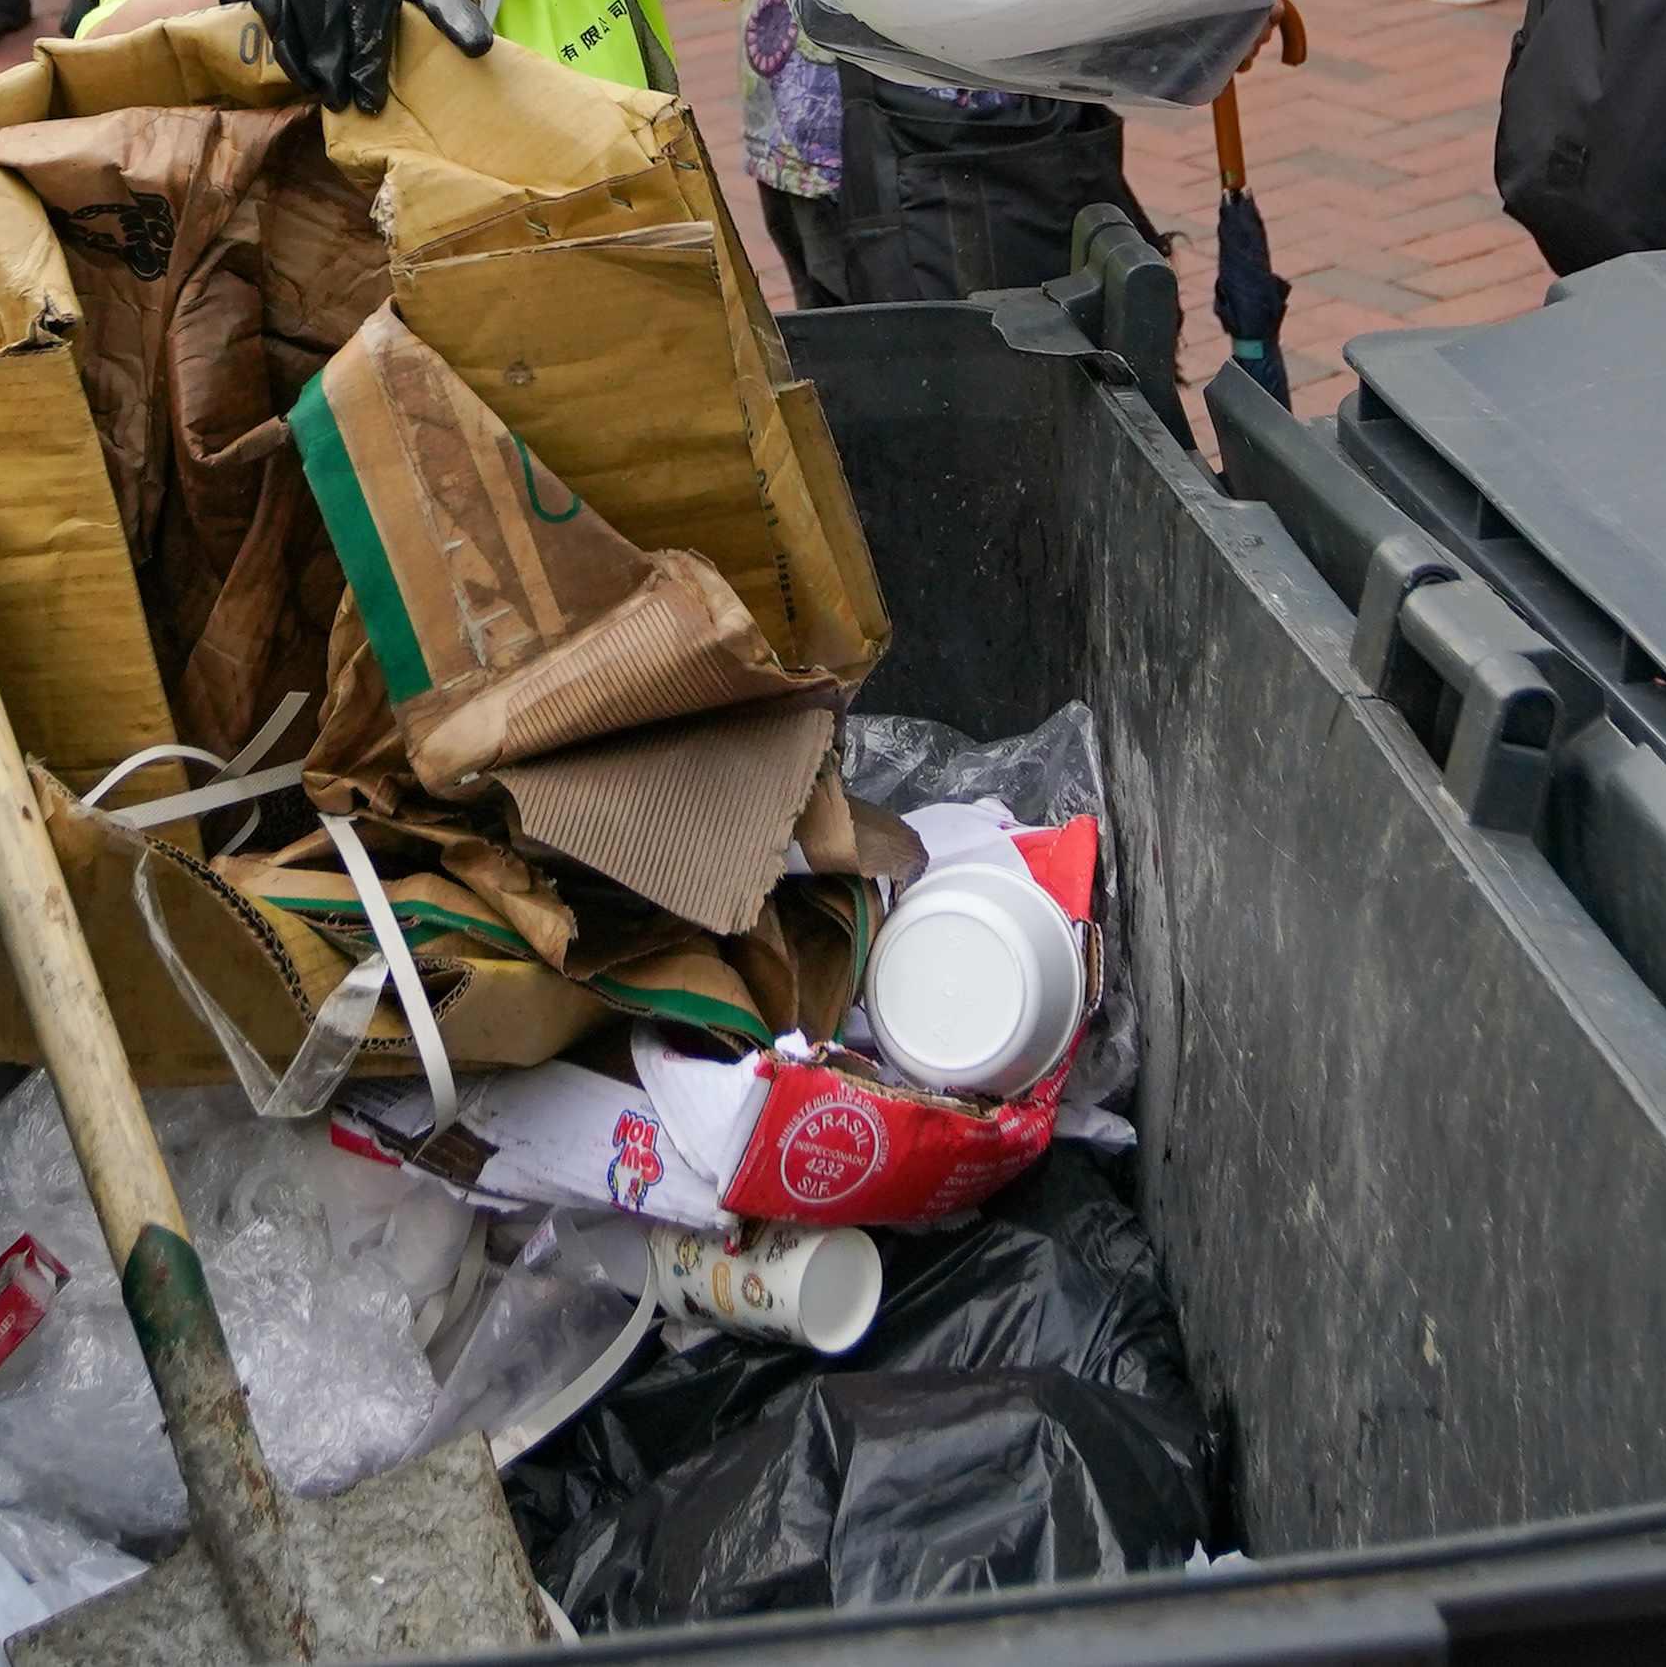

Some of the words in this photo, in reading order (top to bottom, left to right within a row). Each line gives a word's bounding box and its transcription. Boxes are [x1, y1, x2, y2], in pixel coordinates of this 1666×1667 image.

[560, 0, 627, 62] 有限公司
[805, 1112, 870, 1153] BRASIL
[793, 1140, 868, 1167] INSPECIONADO
[804, 1157, 846, 1180] 4232
